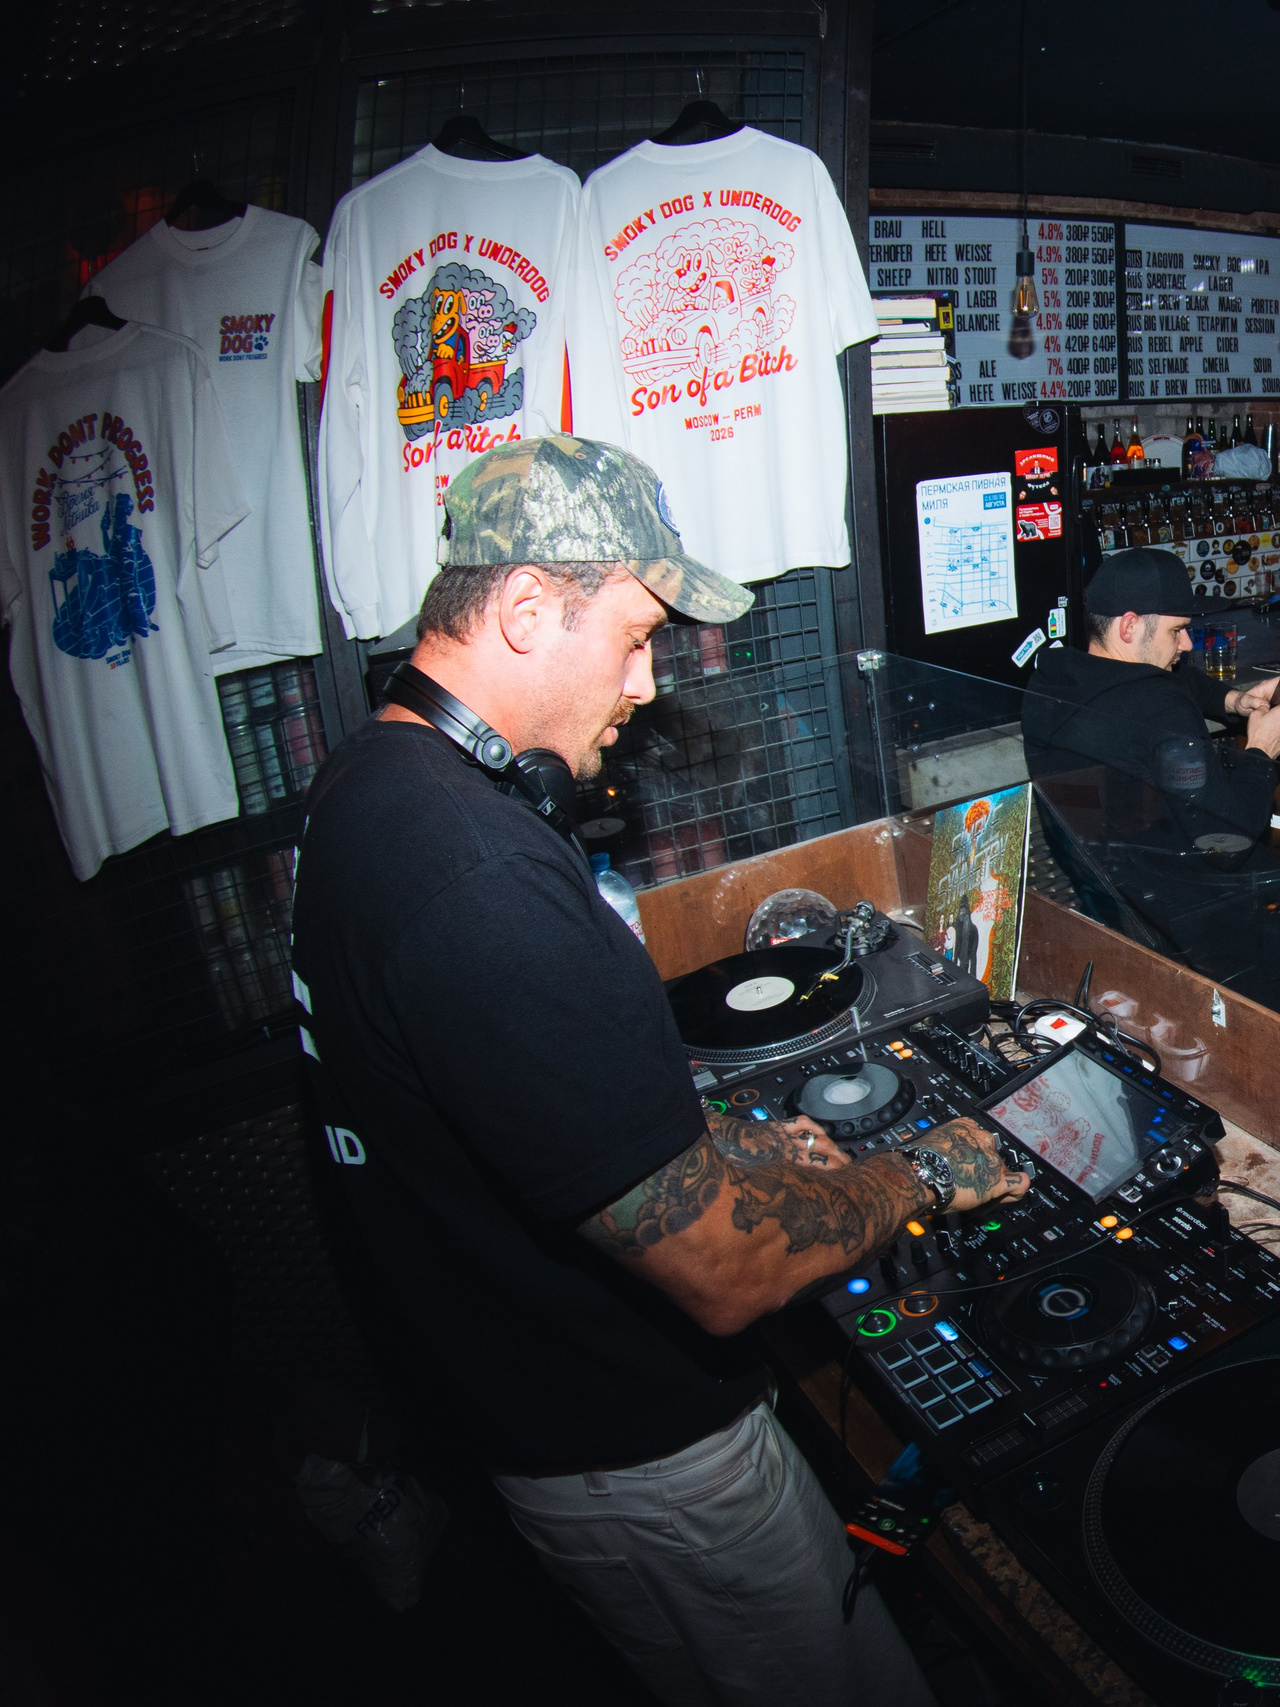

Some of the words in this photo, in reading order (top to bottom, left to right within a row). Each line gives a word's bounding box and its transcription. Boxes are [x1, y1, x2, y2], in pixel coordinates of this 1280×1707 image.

[604, 209, 656, 261] SMOKY
[659, 195, 694, 218] DOG
[702, 191, 712, 207] X
[719, 189, 802, 233] UNDERDOG
[874, 220, 902, 238] BRAU
[922, 220, 946, 238] HELL
[1039, 223, 1063, 240] 4.8%
[1066, 224, 1089, 241] 380₽
[1092, 224, 1114, 243] 550₽
[925, 244, 947, 262] HEFE
[955, 244, 992, 262] WEISSE
[1037, 245, 1062, 263] 4.9%
[1066, 246, 1089, 263] 380₽
[1092, 247, 1114, 264] 550₽
[1146, 252, 1184, 269] ZAGOVOR
[1256, 259, 1269, 275] IPA
[379, 249, 426, 299] SMOKY
[430, 232, 457, 258] DOG
[464, 235, 474, 252] X
[478, 240, 550, 303] UNDERDOG
[877, 267, 911, 287] SHEEP
[927, 268, 959, 286] NITRO
[965, 267, 997, 285] STOUT
[1042, 268, 1058, 285] 5%
[1065, 269, 1089, 286] 200₽
[1091, 270, 1115, 286] 300₽
[1127, 272, 1143, 289] RUS
[1147, 273, 1187, 290] SABOTAGE
[1209, 277, 1233, 292] LAGER
[967, 290, 997, 308] LAGER
[1044, 290, 1061, 307] 5%
[1067, 291, 1090, 308] 200₽
[1093, 292, 1115, 308] 300₽
[1159, 295, 1180, 310] BREW
[1186, 297, 1209, 311] BLACK
[1219, 297, 1242, 313] MAGIC
[1252, 299, 1279, 314] PORTER
[220, 313, 275, 335] SMOKY
[957, 314, 1000, 332] BLANCHE
[1037, 313, 1062, 330] 4.6%
[1066, 314, 1089, 331] 400₽
[1093, 314, 1116, 330] 600₽
[1127, 316, 1142, 332] RUS
[1144, 316, 1156, 331] BIG
[1160, 316, 1190, 332] VILLAGE
[1245, 319, 1275, 334] SESSION
[220, 334, 253, 354] DOG
[1044, 335, 1061, 352] 4%
[1065, 336, 1089, 352] 420₽
[1093, 336, 1116, 352] 640₽
[1127, 337, 1143, 353] RUS
[1149, 337, 1173, 352] REBEL
[1180, 337, 1203, 352] APPLE
[1217, 338, 1239, 353] CIDER
[979, 360, 997, 379] ALE
[1047, 359, 1063, 375] 7%
[1067, 359, 1090, 374] 400₽
[1093, 358, 1117, 374] 600₽
[1128, 358, 1143, 375] RUS
[1149, 358, 1189, 375] SELFMADE
[1254, 358, 1272, 373] SOUR
[631, 384, 681, 416] Son
[686, 367, 713, 406] of
[714, 368, 734, 391] a
[739, 344, 798, 383] Bitch
[1129, 380, 1145, 396] RUS
[1150, 380, 1159, 396] AF
[1165, 379, 1188, 395] BREW
[1227, 379, 1251, 393] TONKA
[1262, 379, 1280, 392] SOUR
[970, 384, 994, 401] HEFE
[1002, 382, 1037, 400] WEISSE
[1041, 381, 1066, 399] 4.4%
[1067, 381, 1091, 397] 200₽
[1095, 380, 1117, 396] 300₽
[684, 414, 719, 430] MOSCOW
[734, 403, 762, 421] PERM
[447, 428, 465, 450] a
[710, 426, 734, 441] 2026
[31, 466, 58, 551] WORK
[48, 412, 98, 469] DONT
[101, 412, 155, 514] PROGRESS
[921, 481, 970, 496] ПЕРМСКАЯ
[972, 477, 1006, 490] ПИВНАЯ
[922, 499, 948, 511] МИЛЯ
[985, 500, 1005, 508] АВГУСТА
